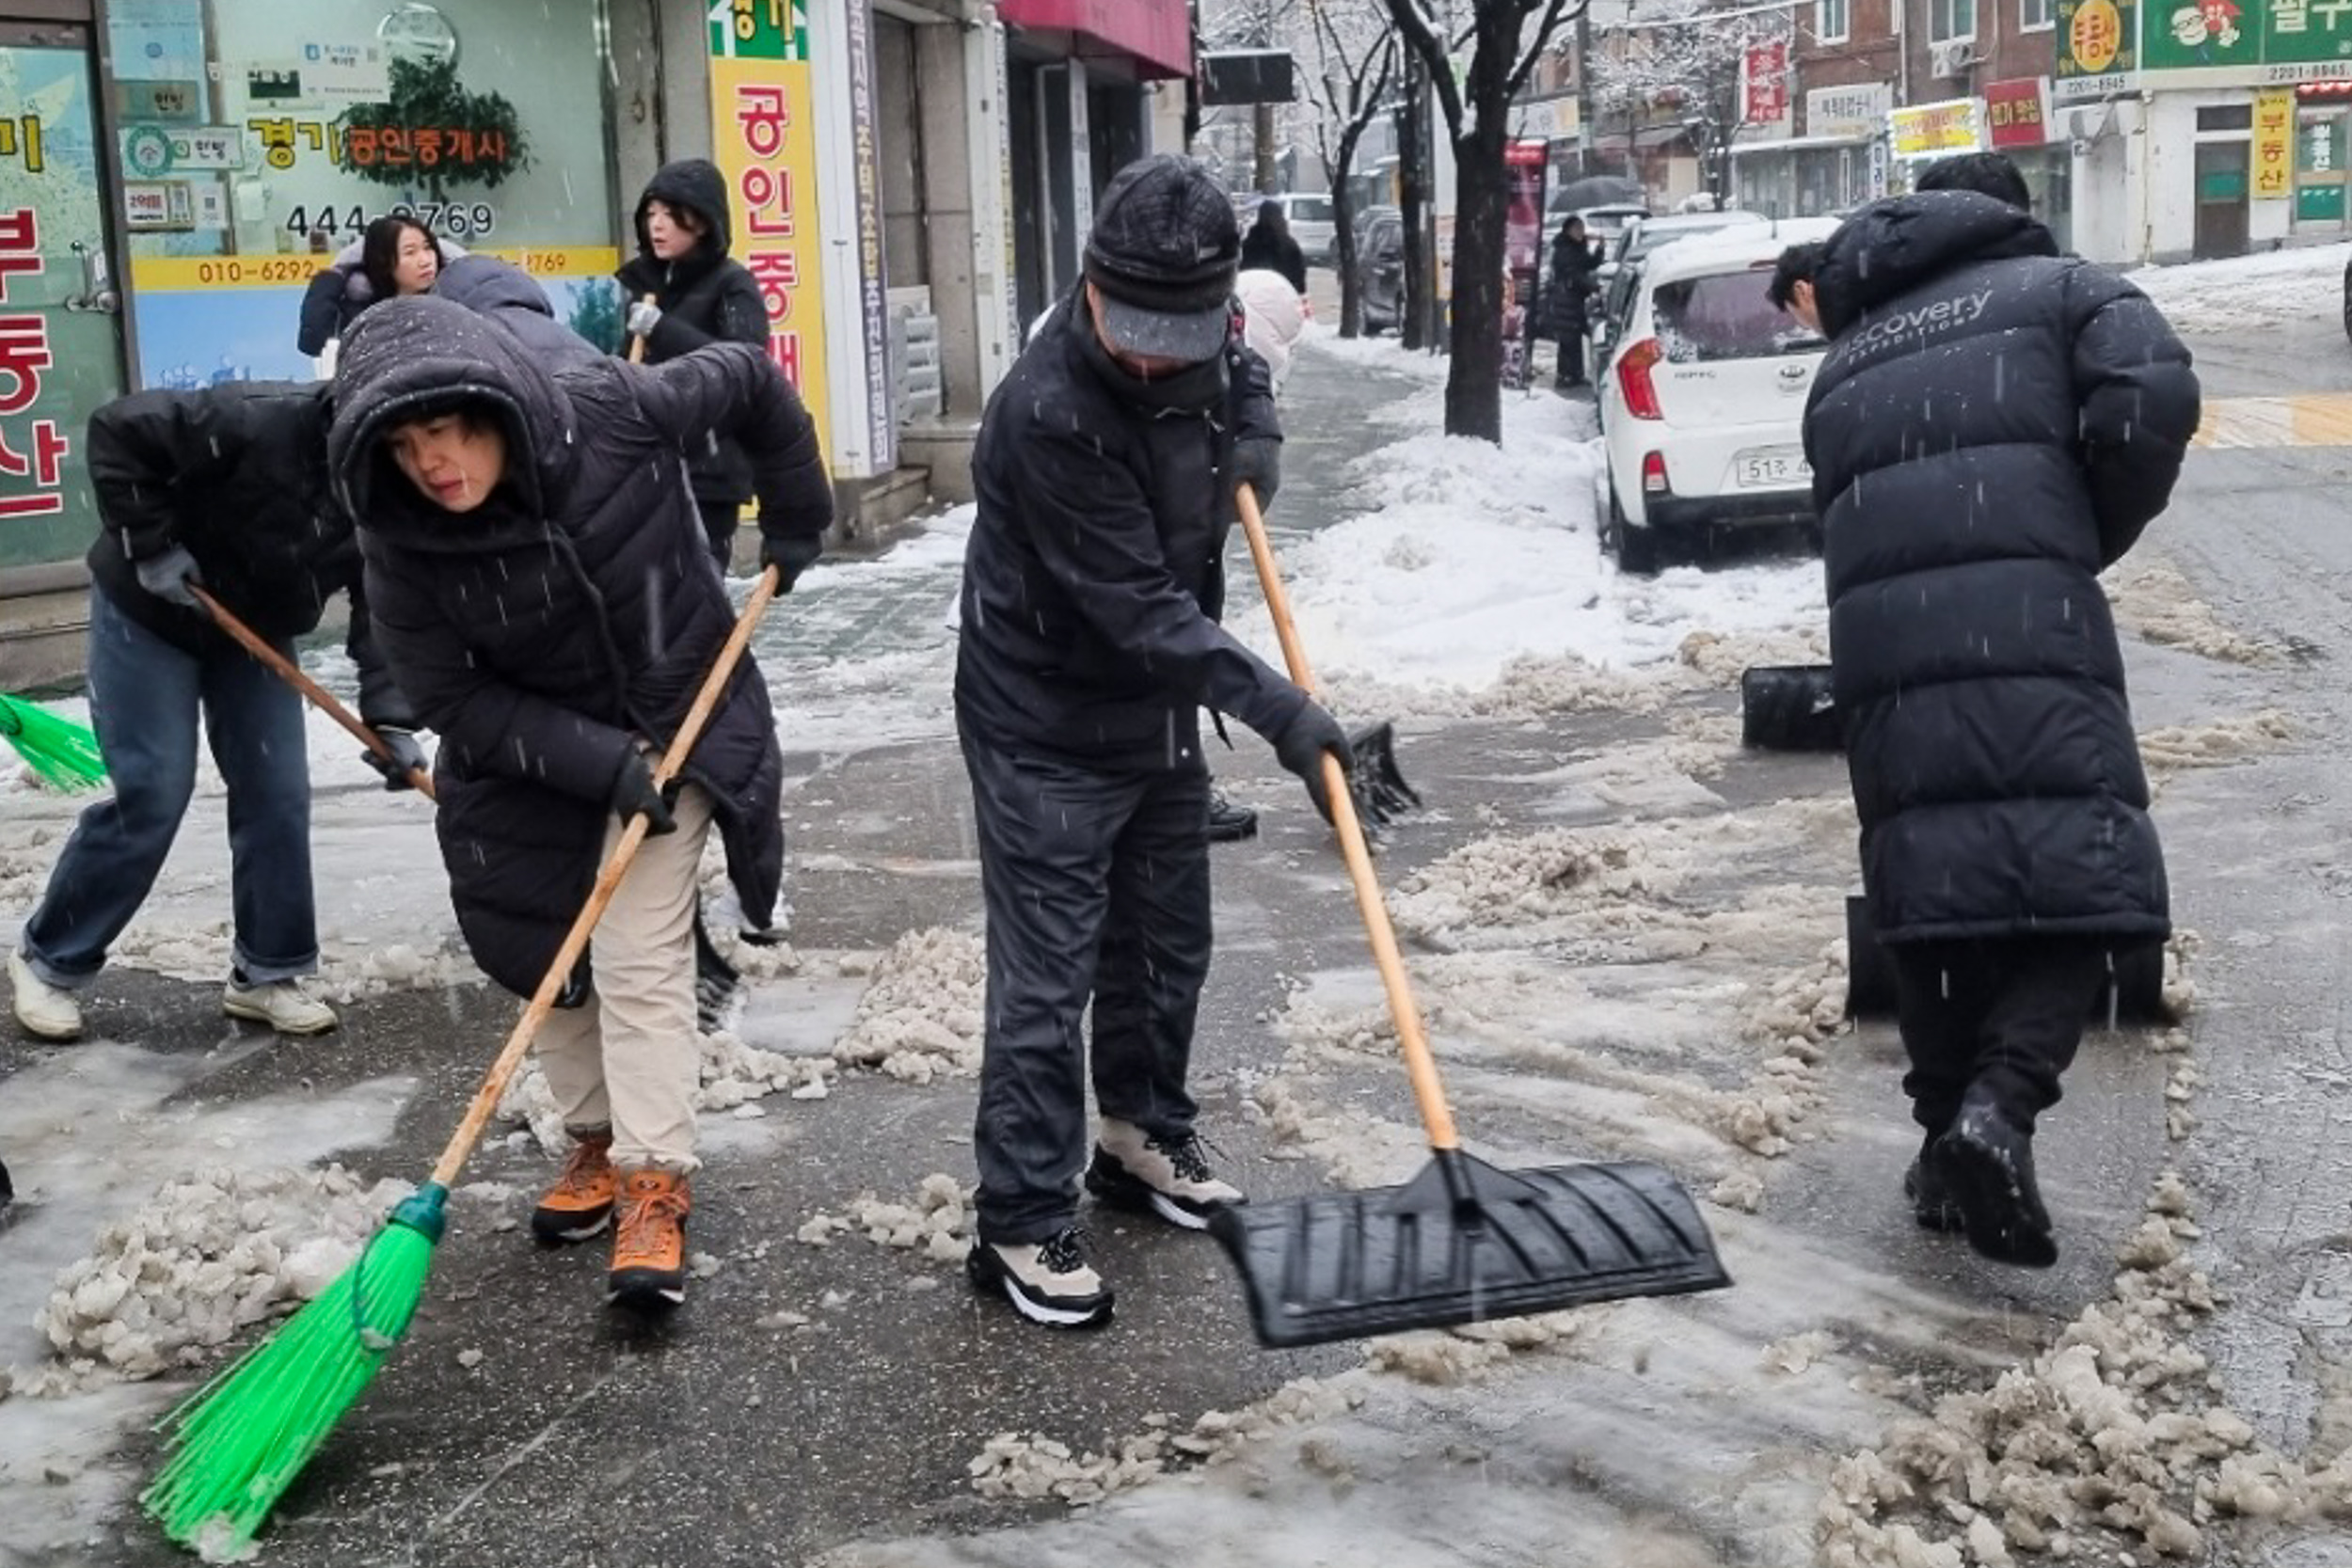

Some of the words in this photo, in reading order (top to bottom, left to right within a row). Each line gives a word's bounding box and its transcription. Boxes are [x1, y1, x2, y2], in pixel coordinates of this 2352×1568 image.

[247, 117, 342, 170] 경기
[344, 123, 507, 166] 공인중개사
[2259, 114, 2285, 191] 부동산
[286, 204, 493, 237] 444769
